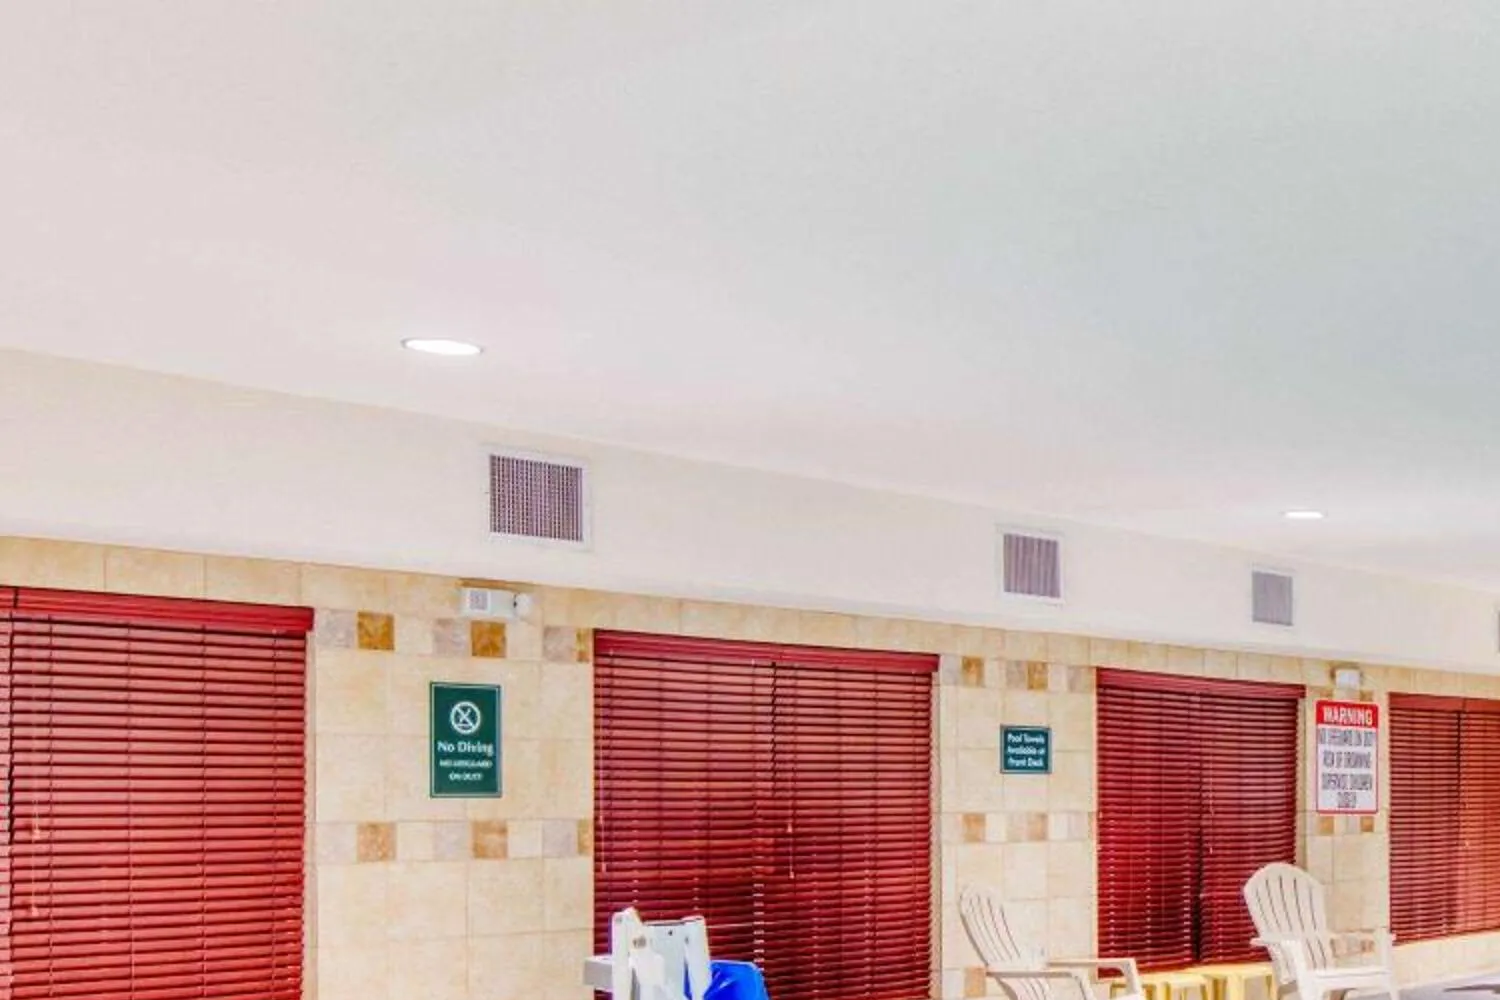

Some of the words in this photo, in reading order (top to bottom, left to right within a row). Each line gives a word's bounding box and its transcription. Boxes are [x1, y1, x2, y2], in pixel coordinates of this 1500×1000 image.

[1323, 706, 1373, 726] WARNING
[437, 741, 455, 753] No
[457, 741, 494, 757] Diving
